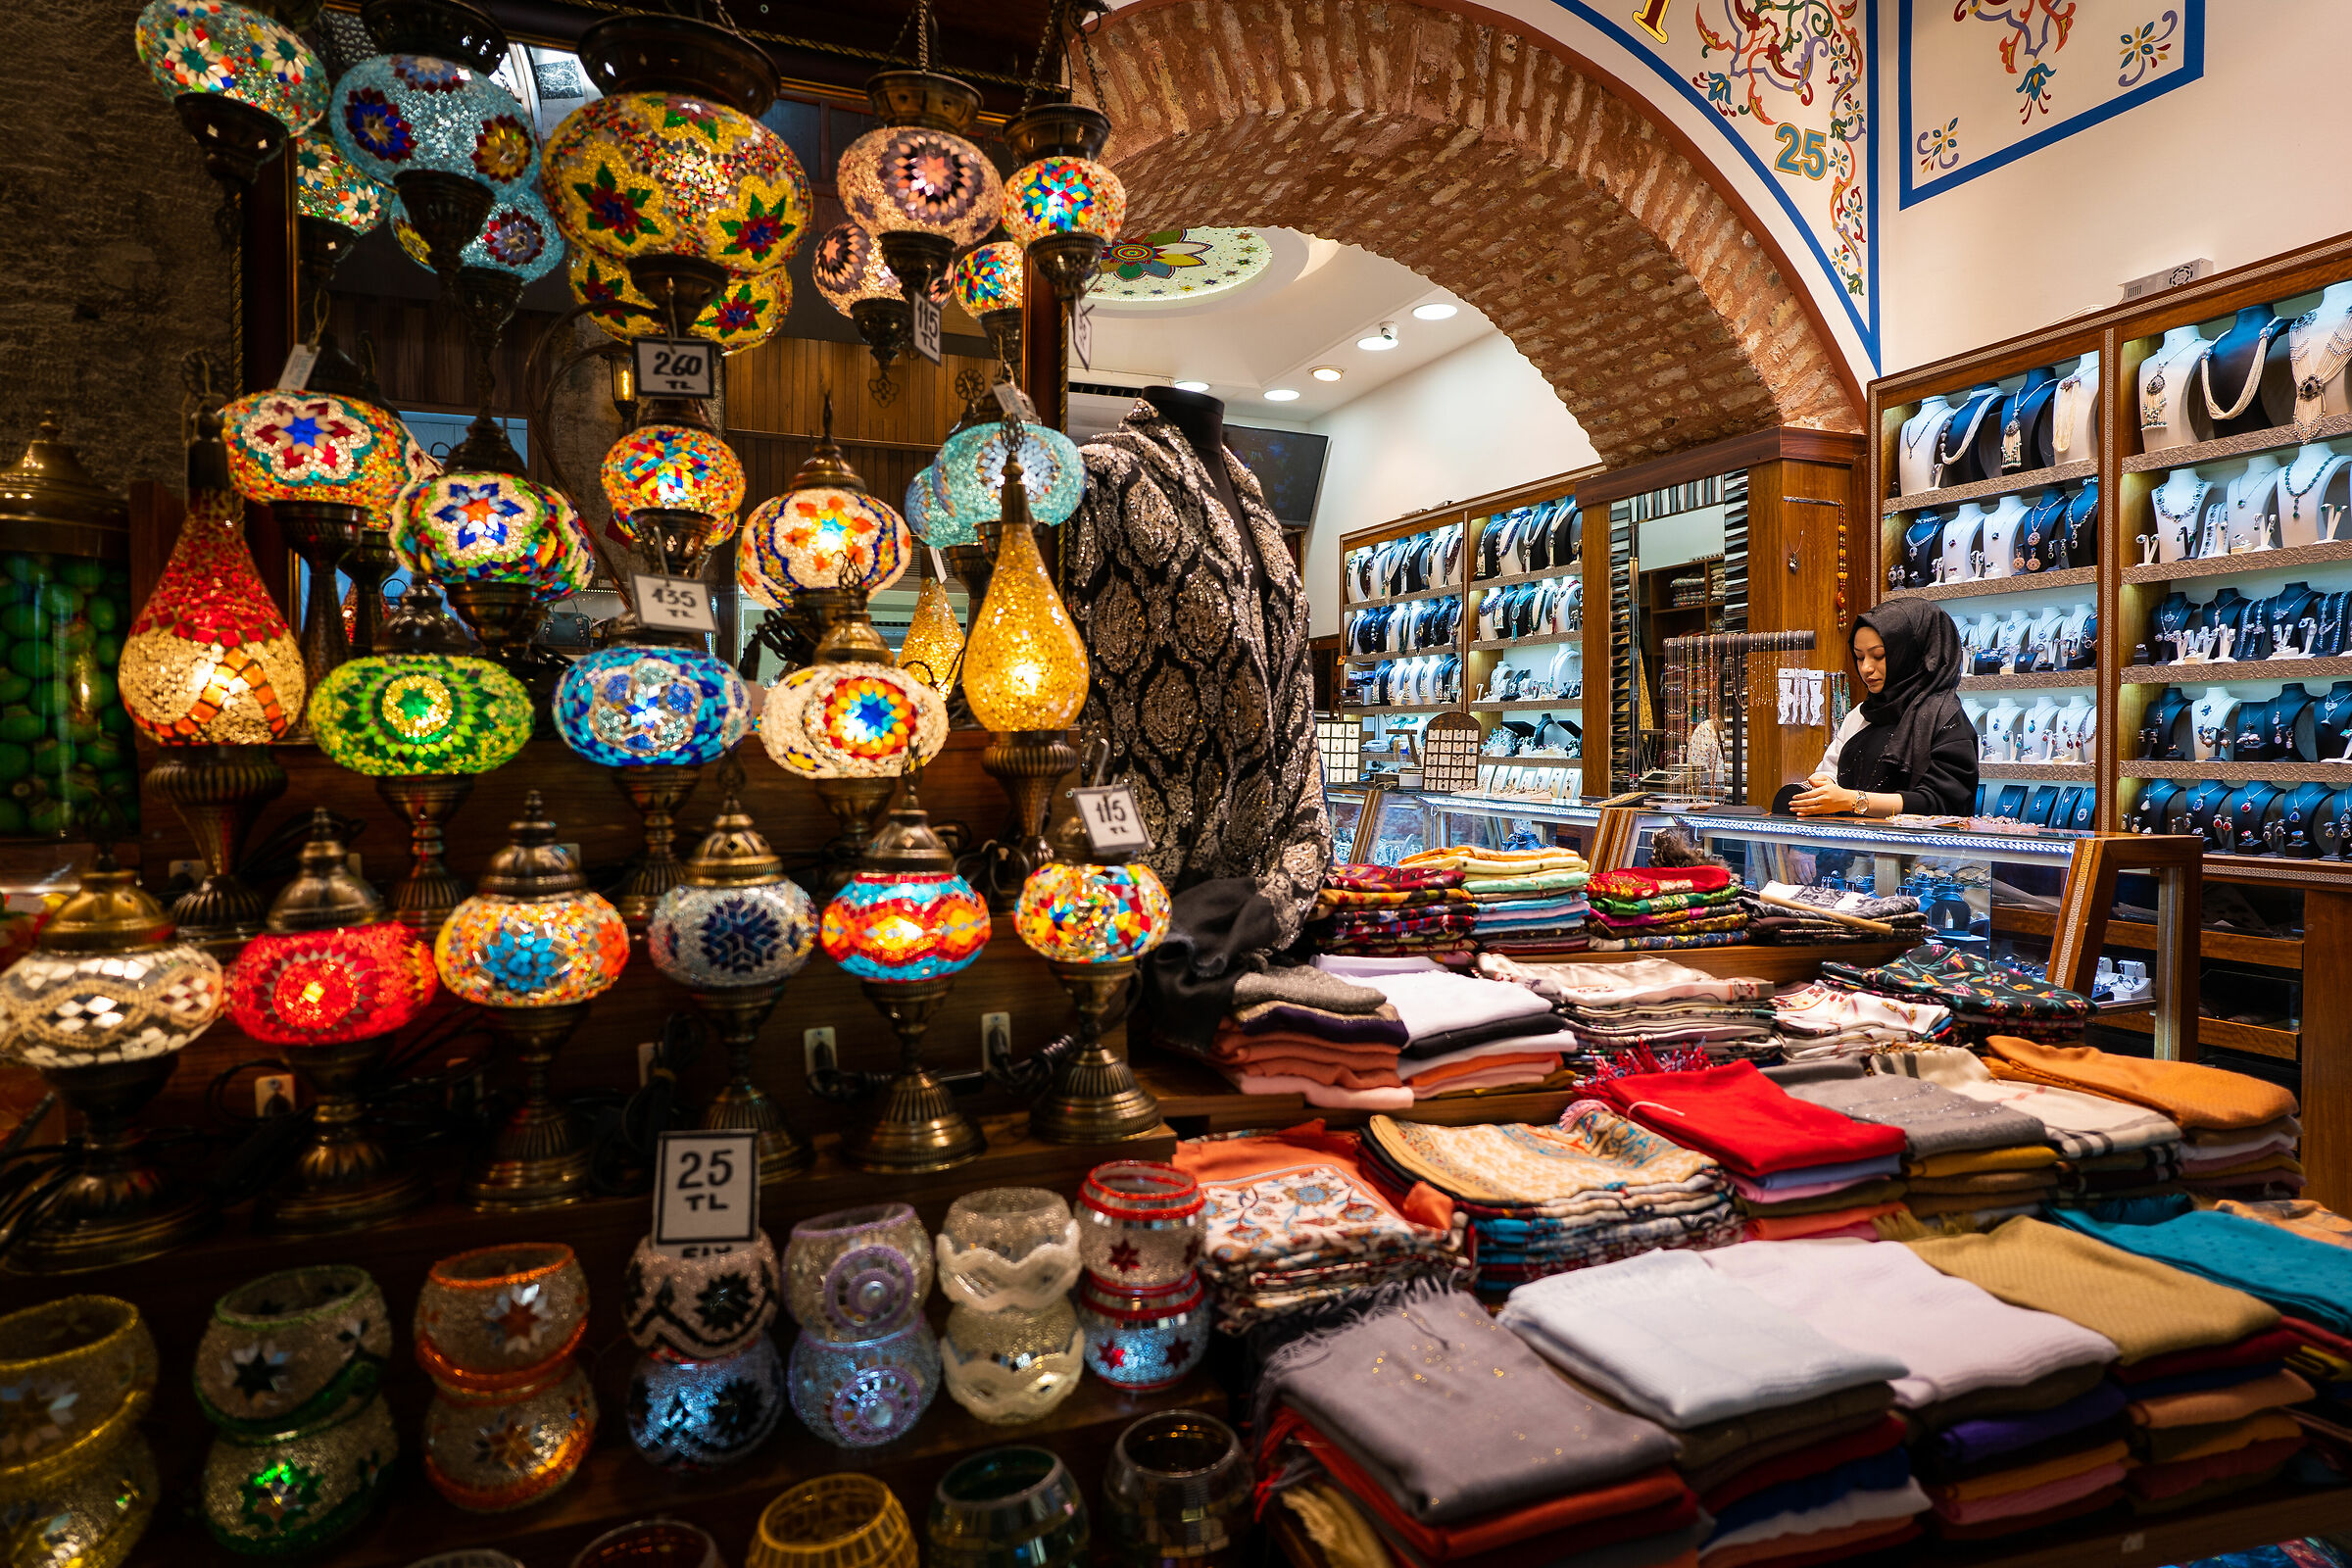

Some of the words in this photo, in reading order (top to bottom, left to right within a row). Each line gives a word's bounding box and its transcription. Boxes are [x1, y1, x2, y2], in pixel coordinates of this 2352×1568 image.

[1775, 122, 1828, 180] 25
[917, 300, 938, 338] 115
[921, 331, 937, 353] TL
[654, 351, 702, 376] 260
[665, 380, 694, 390] TL
[652, 588, 696, 608] 135
[666, 608, 695, 619] TL
[1097, 795, 1126, 822] 115
[677, 1149, 733, 1190] 25
[685, 1194, 728, 1211] TL
